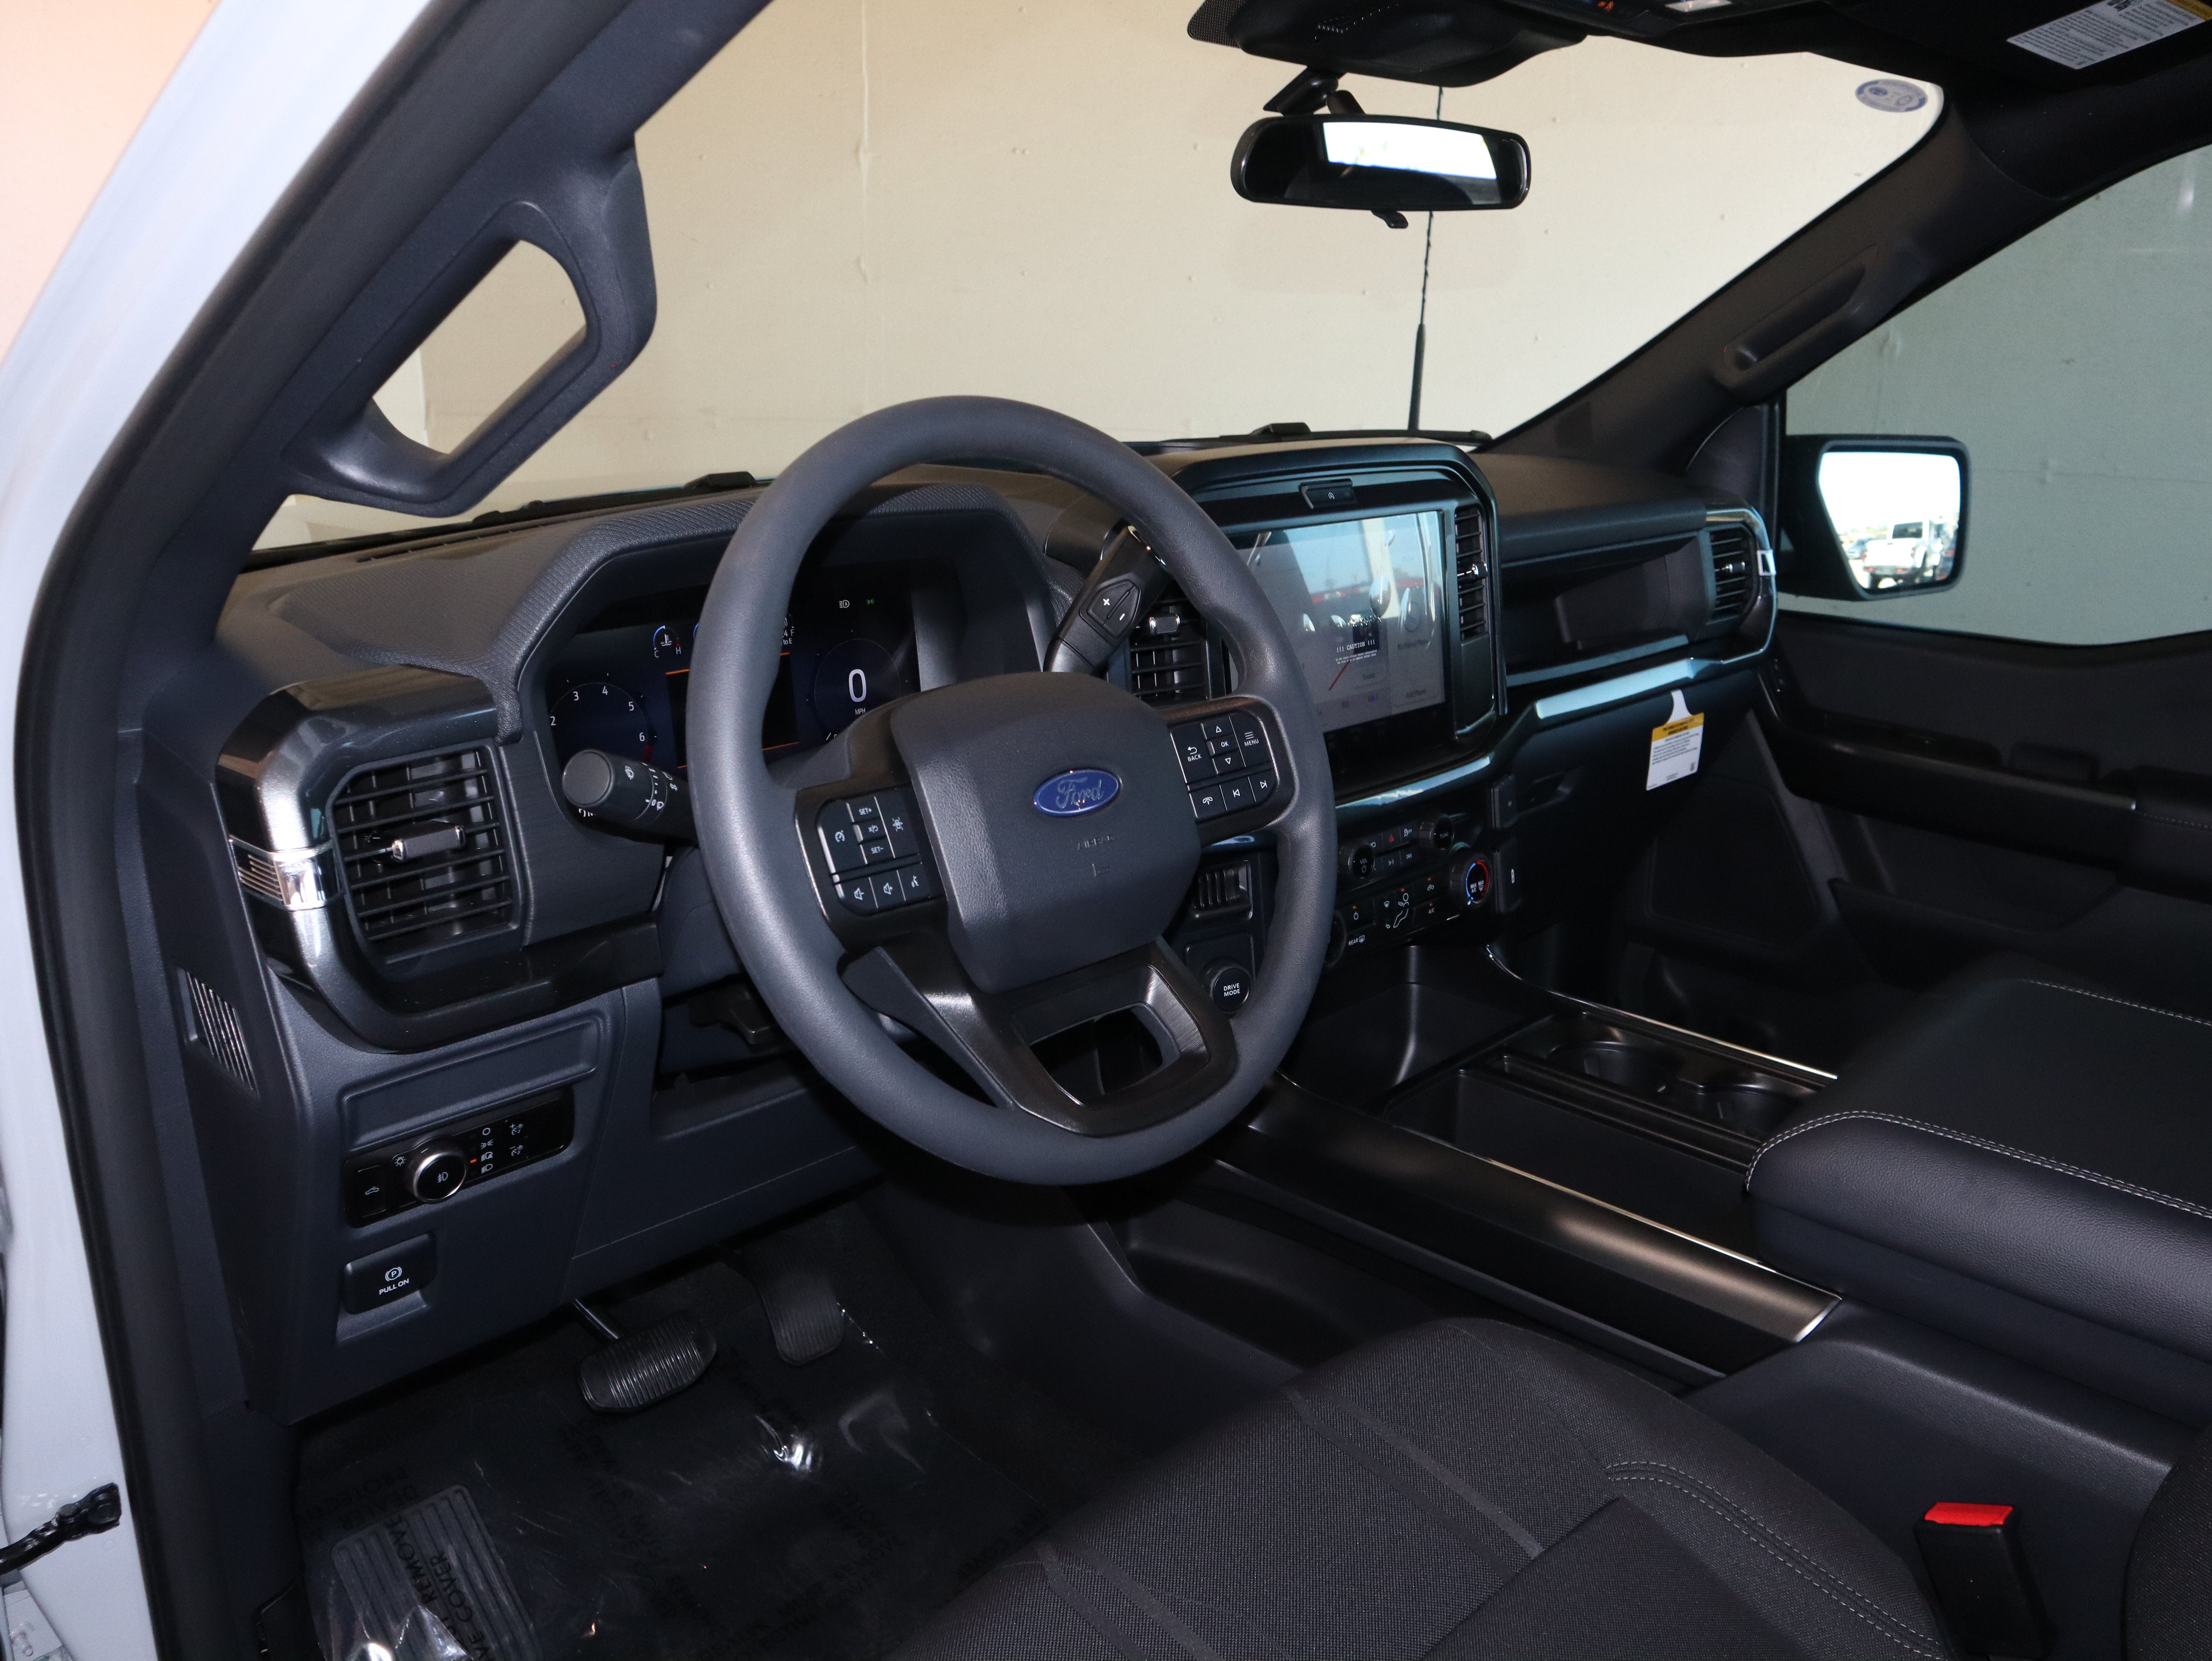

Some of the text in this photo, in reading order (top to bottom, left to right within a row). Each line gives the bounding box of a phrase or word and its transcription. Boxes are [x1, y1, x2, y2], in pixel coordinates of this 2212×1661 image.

[1346, 641, 1365, 650] CAUTION
[675, 647, 681, 655] H
[602, 686, 608, 696] 4
[848, 669, 867, 703] 0
[573, 691, 579, 701] 3
[628, 701, 634, 711] 5
[550, 715, 556, 726] 2
[639, 732, 645, 742] 6
[1244, 739, 1259, 747] MENU
[1187, 754, 1202, 762] BACK
[1055, 777, 1104, 809] Ford
[1348, 938, 1359, 946] REAR
[1223, 982, 1241, 992] DRIVE
[1223, 988, 1241, 997] MODE
[379, 1278, 409, 1295] PULL ON
[384, 1514, 438, 1605] REMOVE
[430, 1550, 473, 1623] COVER
